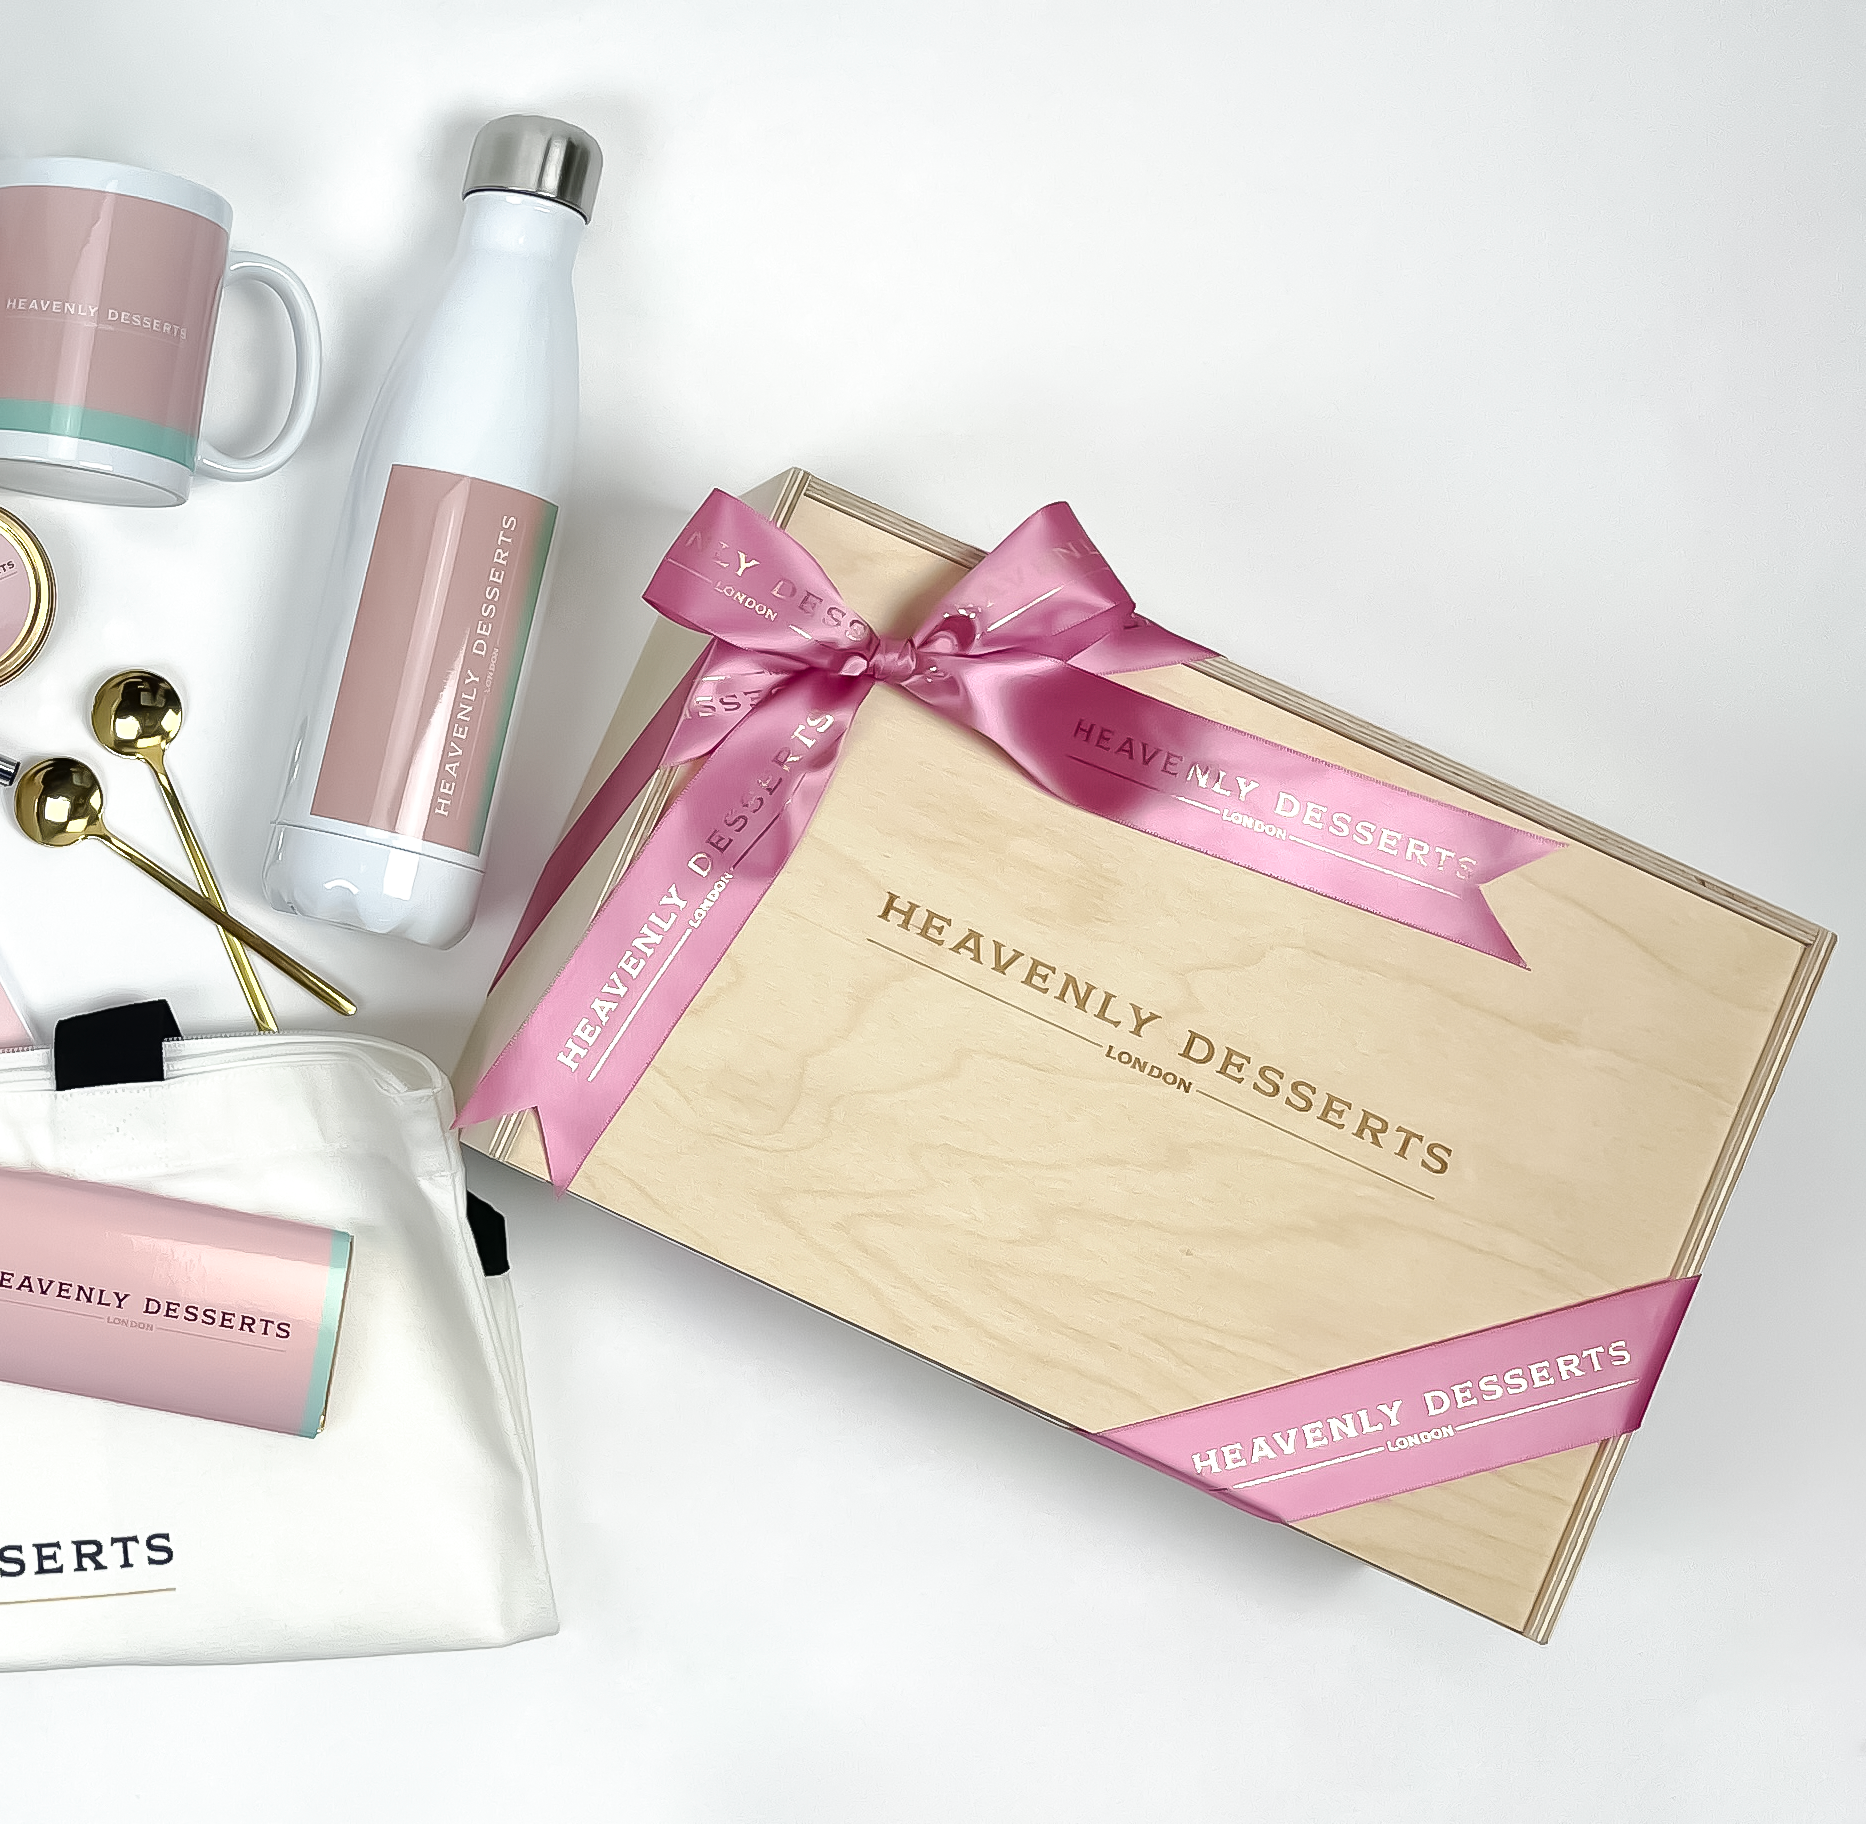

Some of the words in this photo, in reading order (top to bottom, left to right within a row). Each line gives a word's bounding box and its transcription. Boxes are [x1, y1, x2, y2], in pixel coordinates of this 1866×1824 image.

[6, 297, 99, 318] HEAVENLY
[107, 309, 188, 341] DESSERTS
[714, 580, 778, 622] LONDON
[435, 669, 481, 817] HEAVENLY
[472, 514, 518, 658] DESSERTS
[484, 647, 499, 694] LONDON
[1073, 718, 1260, 802] HEAVENLY
[1273, 791, 1478, 880] DESSERTS
[1222, 808, 1288, 841] LONDON
[556, 883, 688, 1073] HEAVENLY
[687, 714, 835, 878] DESSERTS
[688, 872, 734, 929] LONDON
[876, 891, 1162, 1038] HEAVENLY
[1178, 1029, 1454, 1177] DESSERTS
[1104, 1043, 1194, 1095] LONDON
[107, 1315, 155, 1332] LONDON
[143, 1297, 292, 1340] DESSERTS
[1191, 1399, 1404, 1476] HEAVENLY
[1423, 1340, 1632, 1417] DESSERTS
[1386, 1424, 1456, 1453] LONDON
